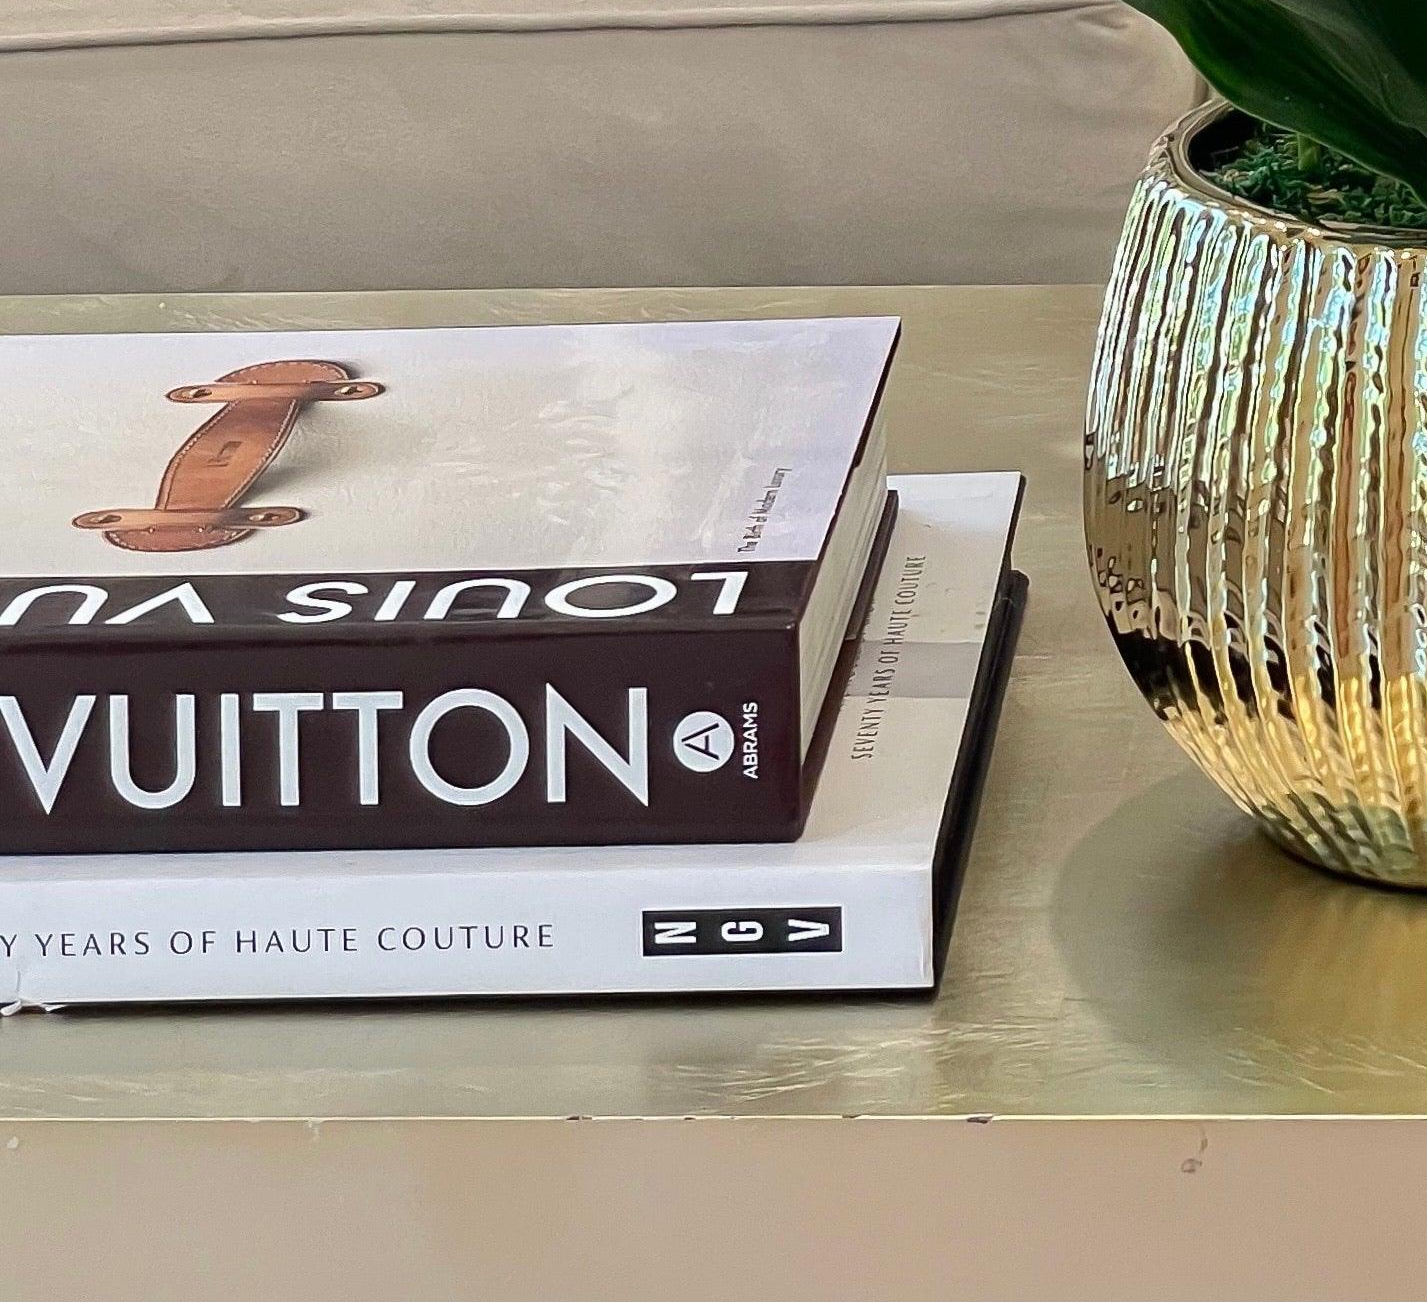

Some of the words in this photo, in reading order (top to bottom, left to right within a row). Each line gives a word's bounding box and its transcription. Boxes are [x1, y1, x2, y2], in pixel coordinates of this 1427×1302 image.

[275, 570, 750, 624] LOUIS
[894, 555, 927, 606] COUTURE
[883, 608, 912, 645] HAUTE
[878, 647, 901, 667] OF
[867, 667, 896, 705] YEARS
[0, 683, 649, 816] VUITTON
[742, 701, 759, 780] ABRAMS
[850, 707, 885, 760] SEVENTY
[34, 931, 151, 957] YEARS
[169, 930, 217, 955] OF
[235, 927, 358, 954] HAUTE
[377, 923, 554, 952] COUTURE
[654, 918, 830, 946] NGV
